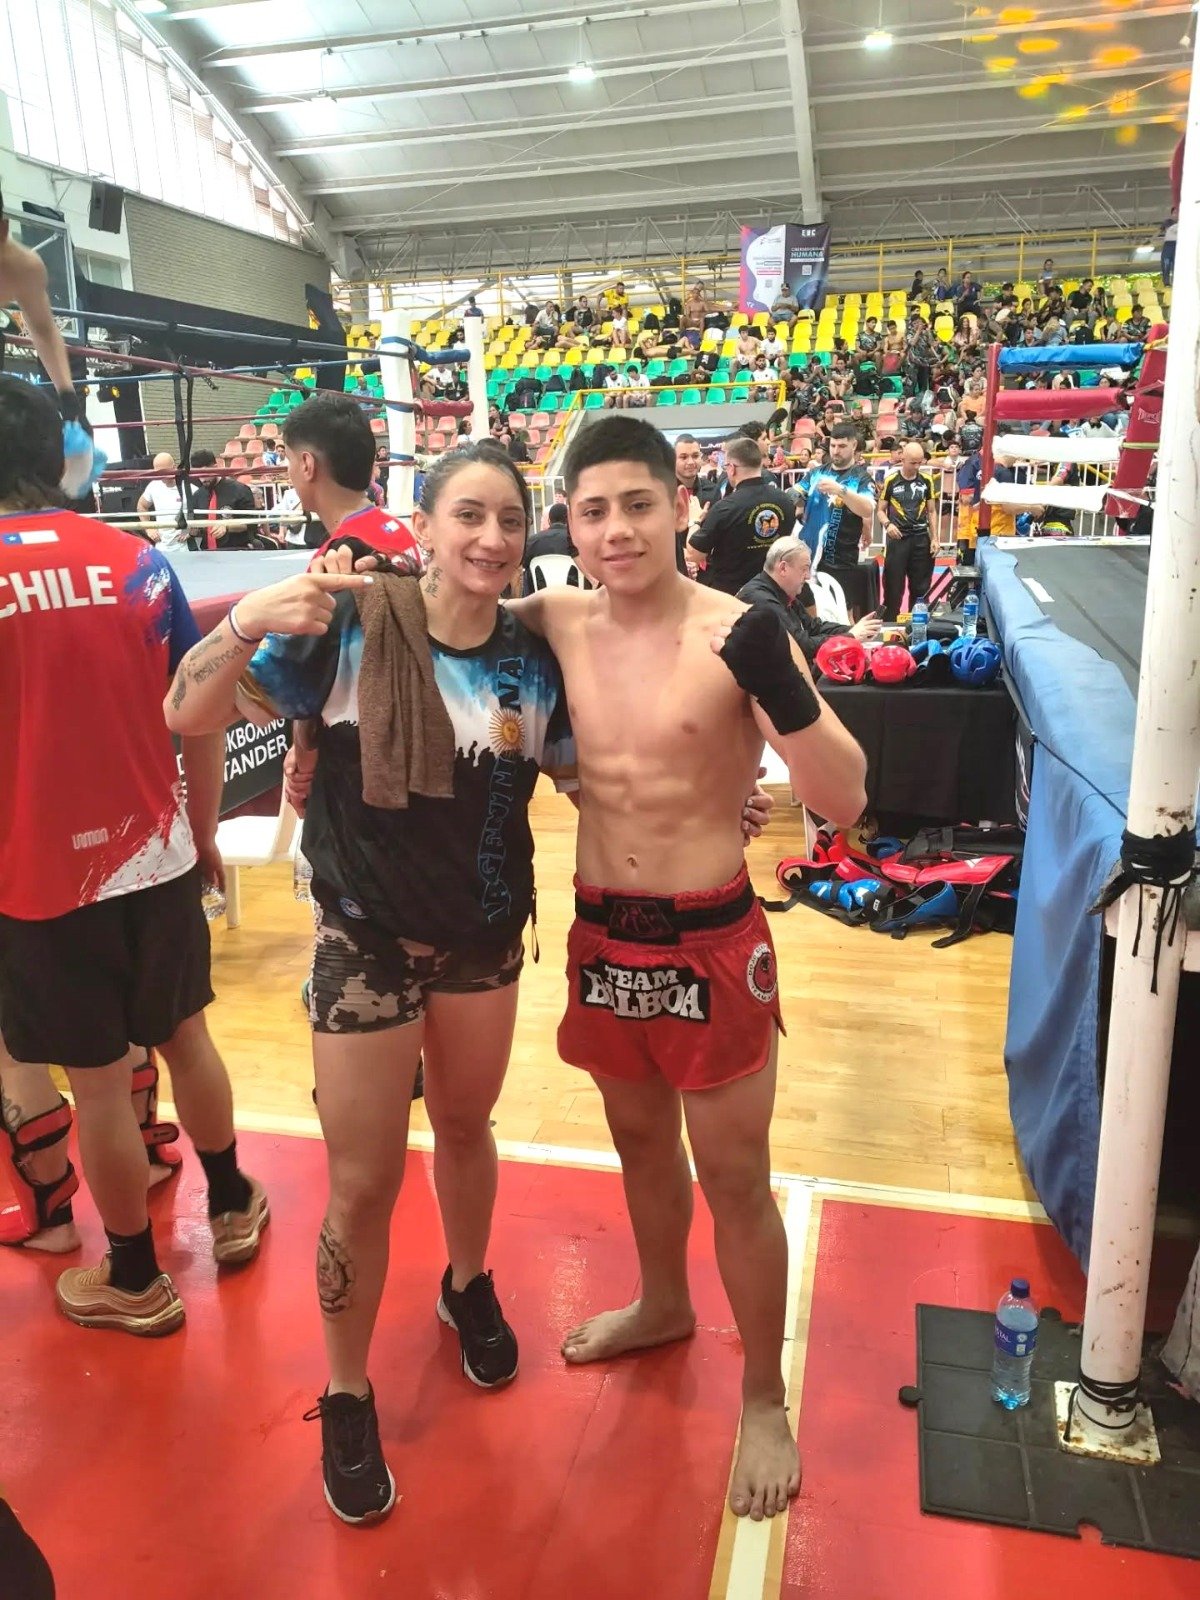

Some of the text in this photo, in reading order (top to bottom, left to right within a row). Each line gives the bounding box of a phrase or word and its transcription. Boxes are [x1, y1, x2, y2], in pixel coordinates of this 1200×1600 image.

[0, 565, 118, 619] CHILE
[225, 717, 286, 754] KBOXING
[604, 964, 680, 991] TEAM
